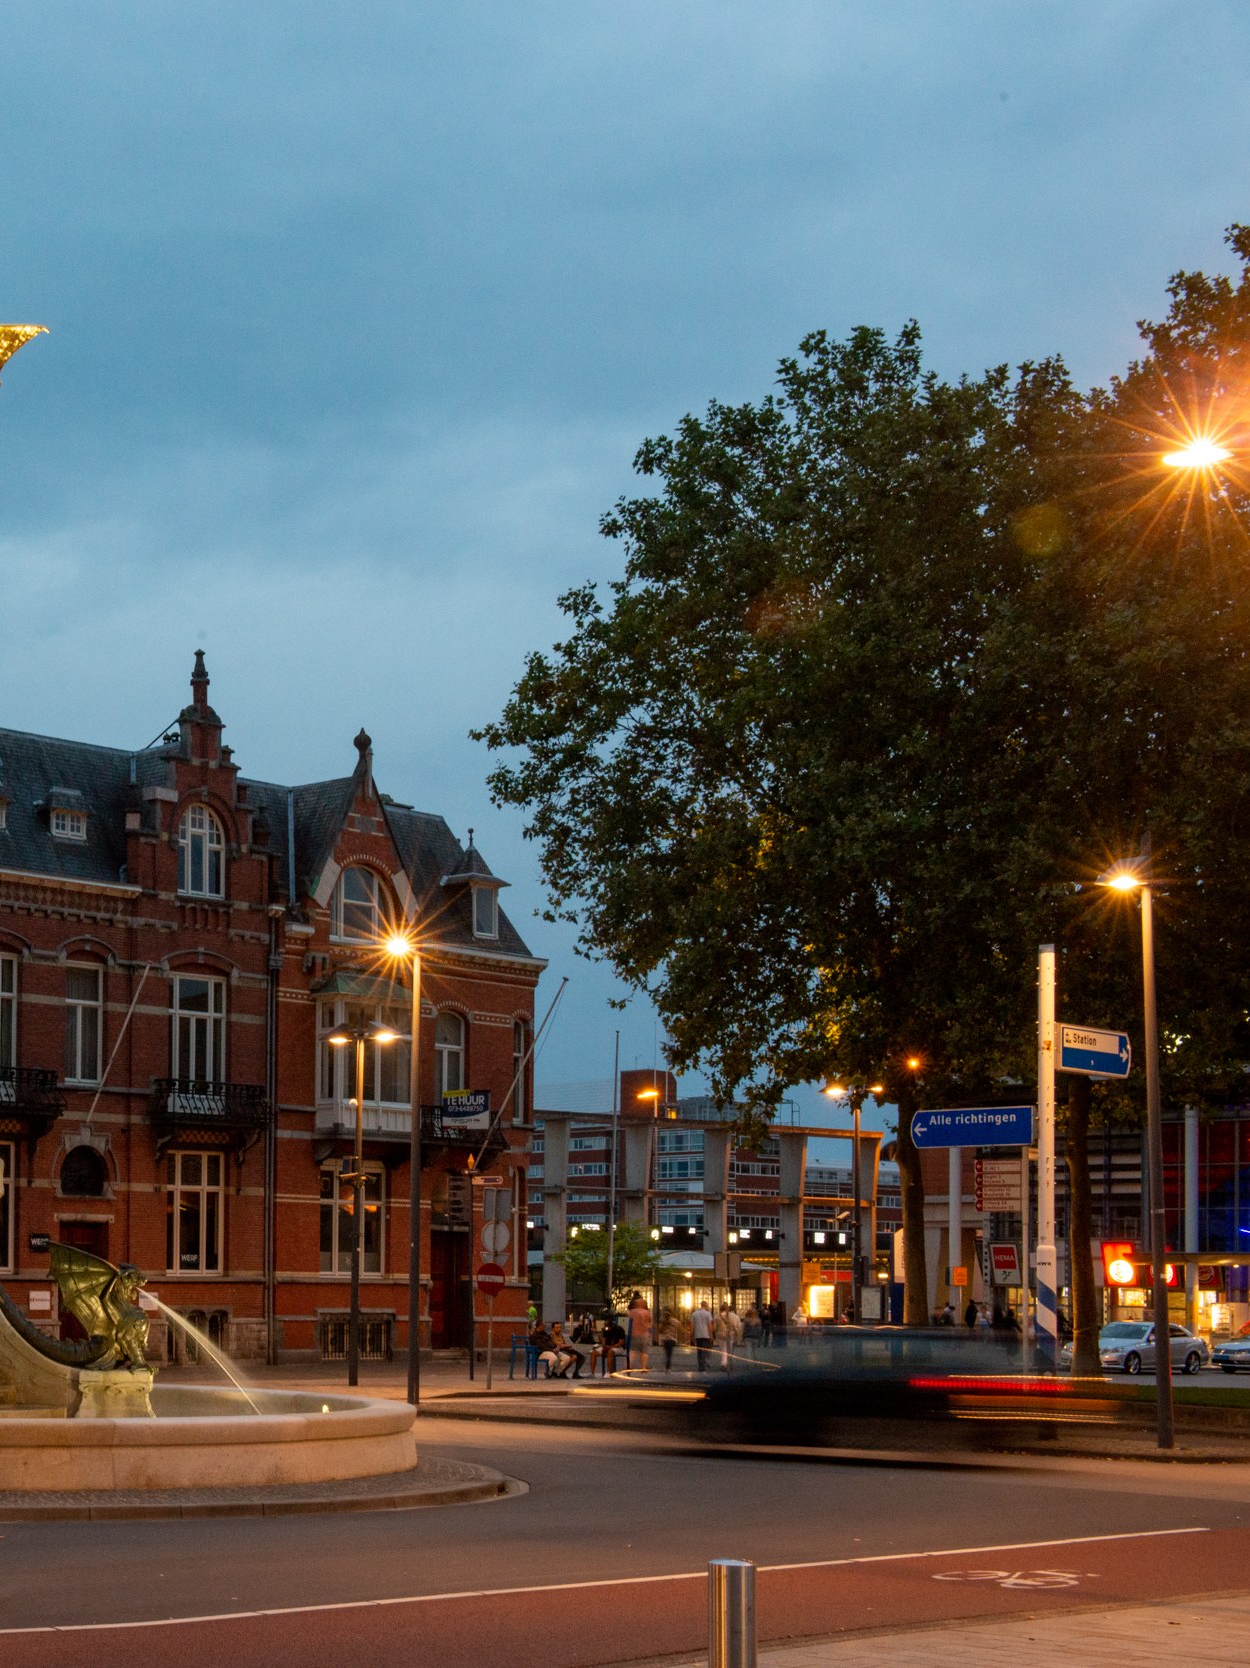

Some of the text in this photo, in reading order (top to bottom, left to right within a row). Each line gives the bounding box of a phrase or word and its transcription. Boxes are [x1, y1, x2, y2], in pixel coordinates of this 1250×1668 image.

[1073, 1033, 1097, 1047] Station
[447, 1095, 485, 1105] TE HUUR
[929, 1113, 1017, 1126] Alle richtingen
[180, 1253, 198, 1262] WERF
[994, 1254, 1015, 1262] HEMA
